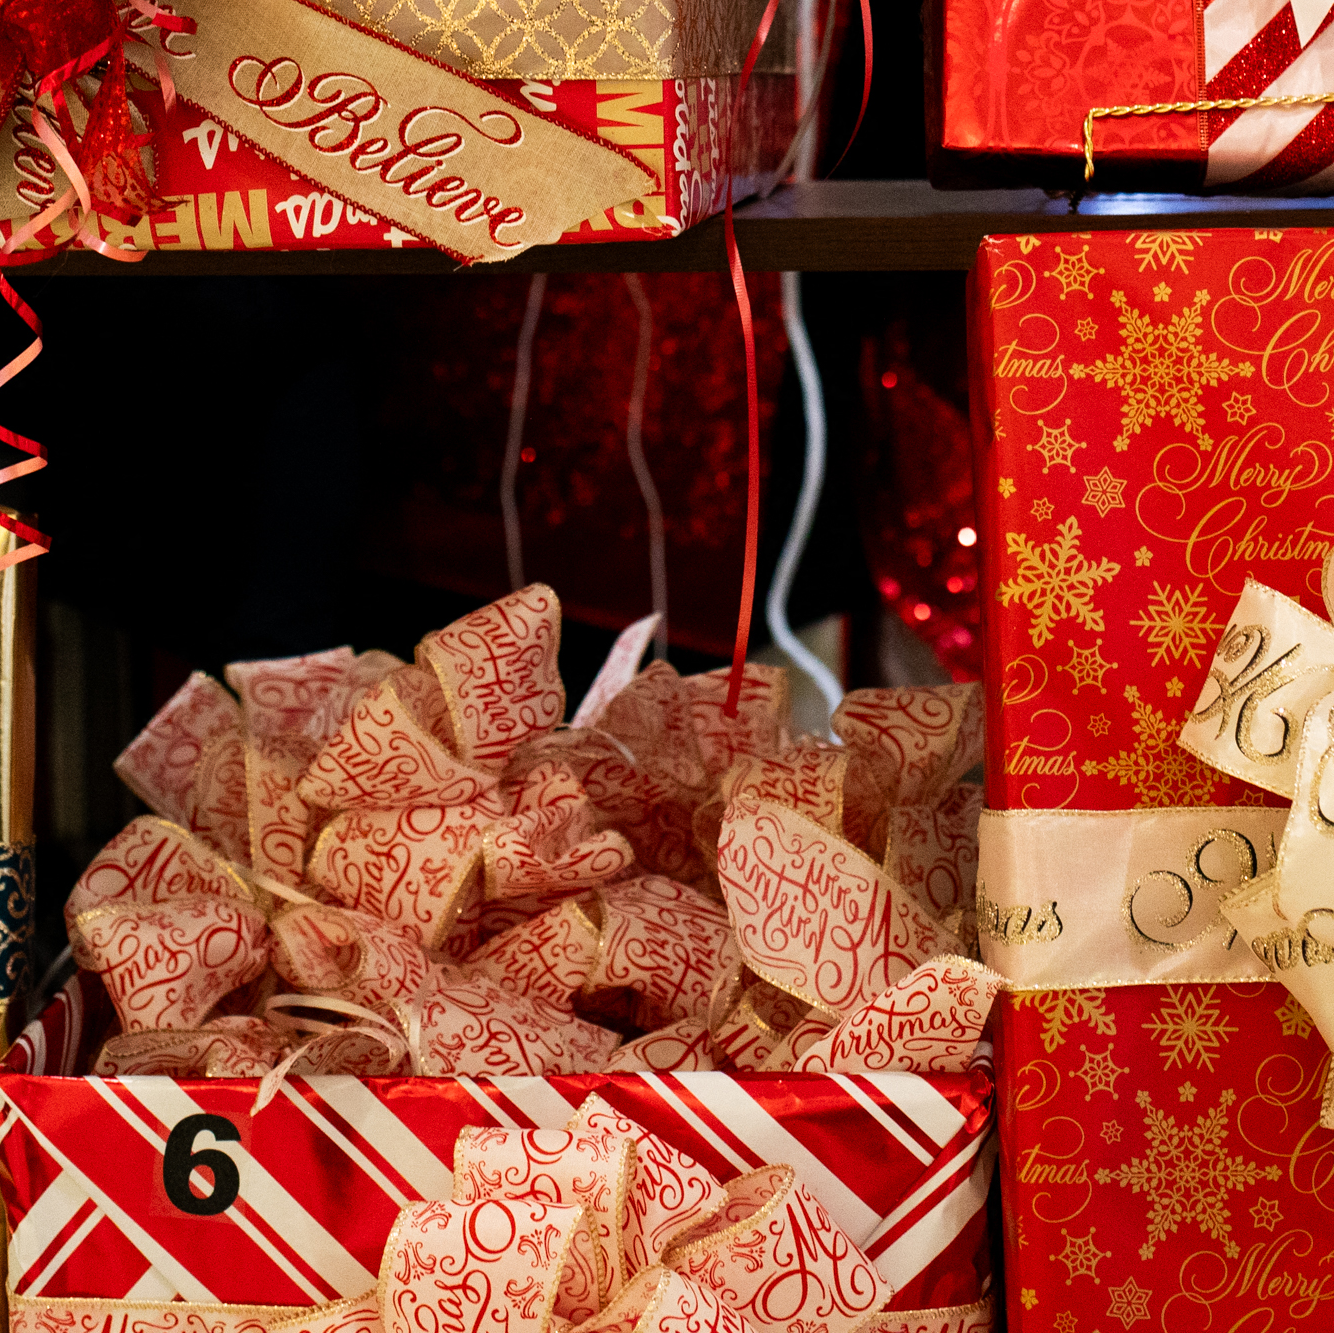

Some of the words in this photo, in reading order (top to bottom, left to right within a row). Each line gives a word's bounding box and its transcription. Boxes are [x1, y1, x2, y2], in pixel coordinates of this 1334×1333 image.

[228, 54, 525, 249] Believe
[1154, 423, 1333, 508] Merry
[162, 1113, 243, 1216] 6
